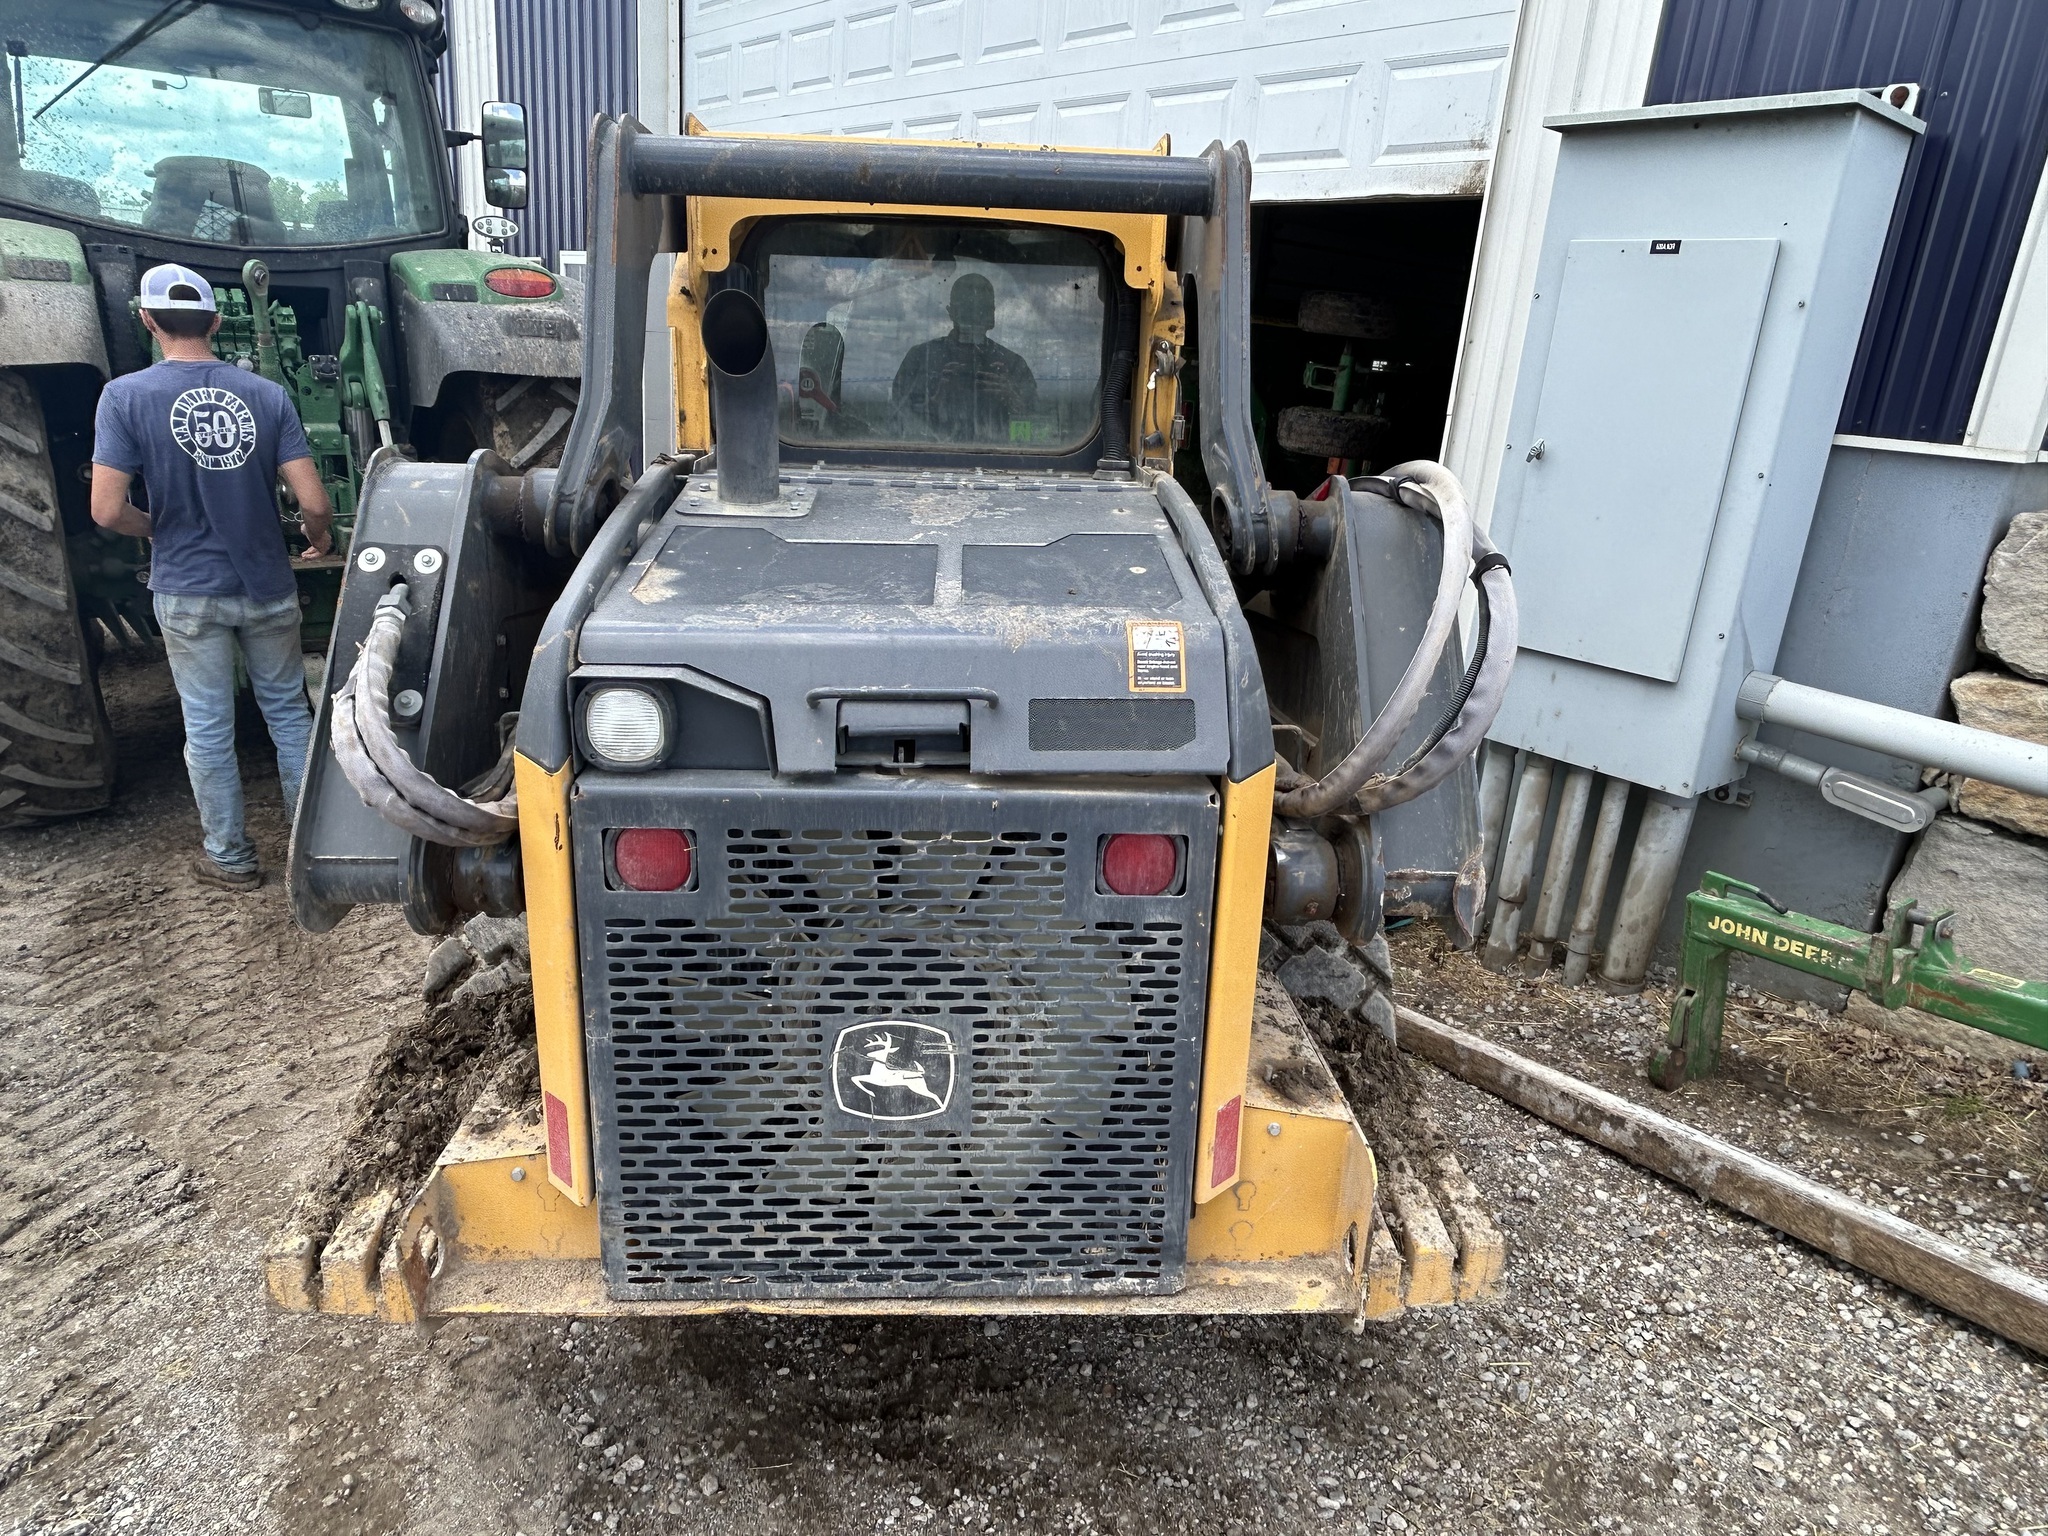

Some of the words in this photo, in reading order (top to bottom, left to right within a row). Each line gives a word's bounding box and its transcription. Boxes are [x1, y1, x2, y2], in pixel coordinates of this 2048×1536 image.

[176, 389, 216, 412] DAIRY
[223, 393, 254, 442] FARMS
[193, 410, 234, 448] 50
[1708, 915, 1768, 946] JOHN
